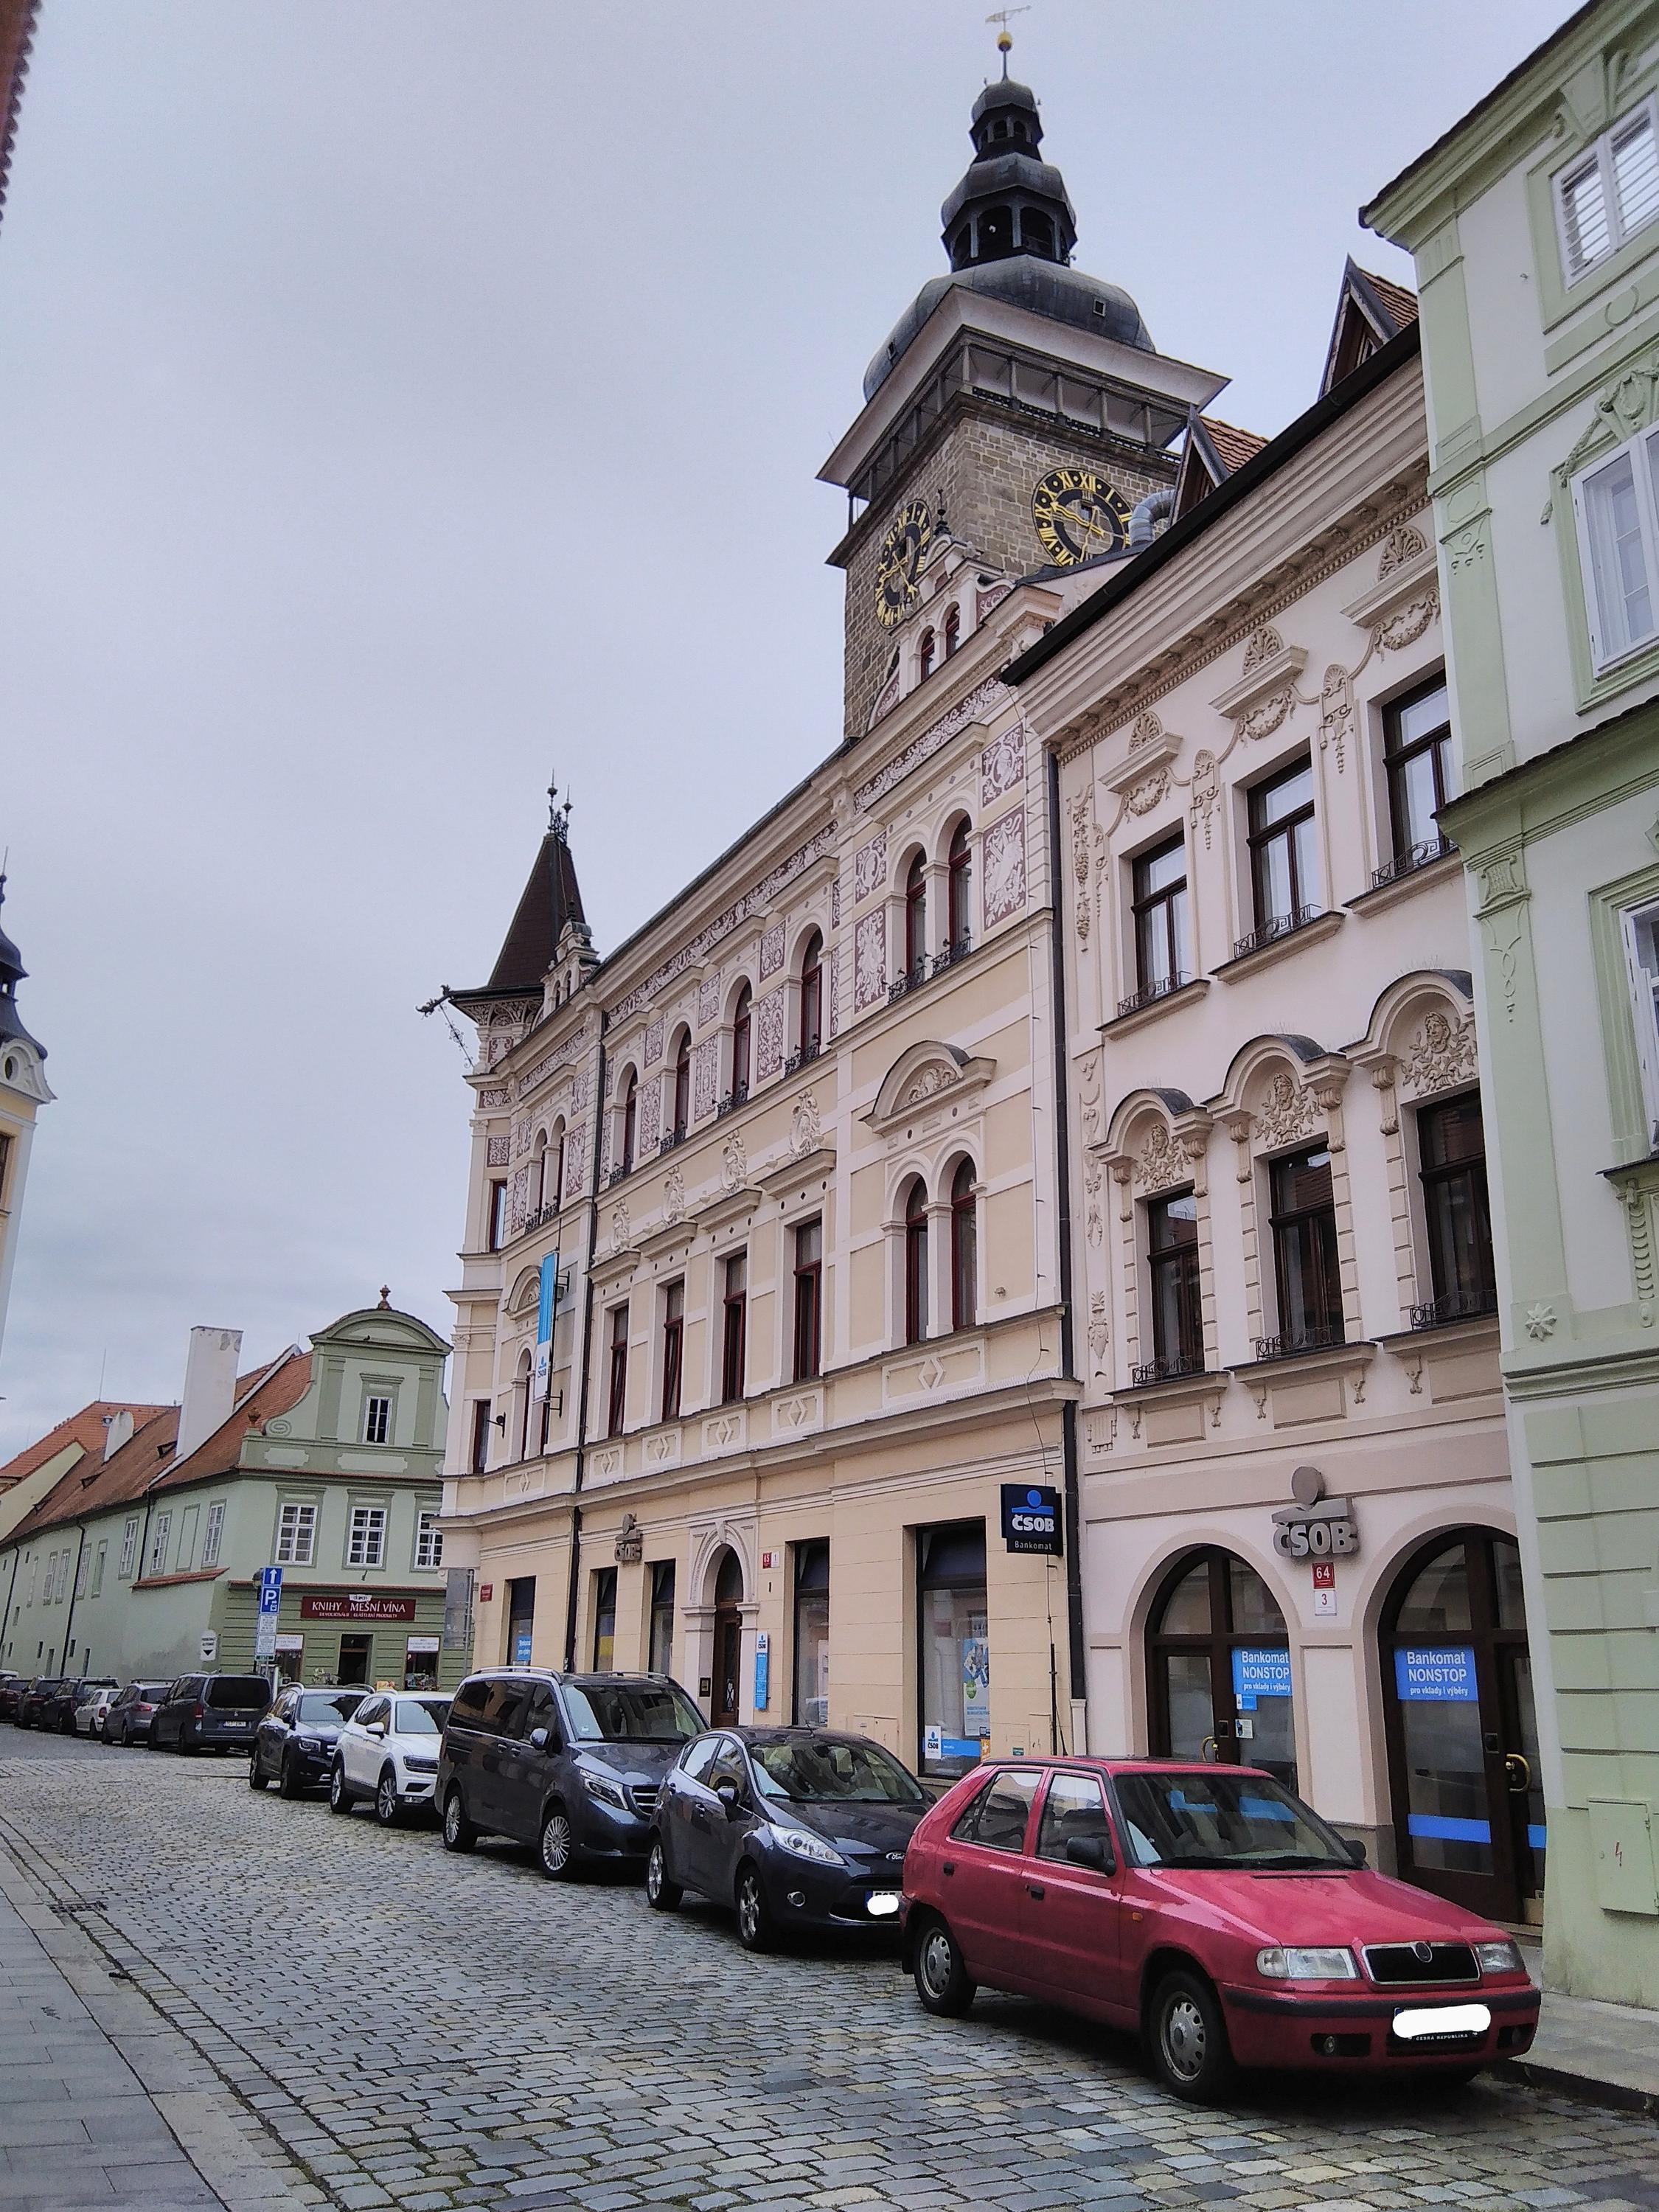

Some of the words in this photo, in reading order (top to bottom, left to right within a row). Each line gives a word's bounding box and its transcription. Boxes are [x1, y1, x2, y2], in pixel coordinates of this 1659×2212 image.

[1056, 471, 1074, 489] XI
[1079, 472, 1096, 493] XII
[1040, 483, 1057, 502] X
[1012, 1514, 1054, 1532] ČSOB
[1015, 1540, 1052, 1551] Bankomat
[1273, 1521, 1359, 1557] ČSOB
[1316, 1565, 1330, 1579] 64
[265, 1589, 277, 1606] P
[1321, 1593, 1327, 1605] 3
[312, 1601, 342, 1611] KNIHY
[350, 1601, 380, 1612] MEŠNÍ
[383, 1601, 406, 1613] VÍNA
[1242, 1651, 1289, 1663] Bankomat
[1407, 1651, 1466, 1665] Bankomat
[1242, 1666, 1290, 1679] NONSTOP
[1408, 1668, 1467, 1682] NONSTOP
[1410, 1687, 1421, 1696] pro
[1422, 1686, 1441, 1696] vklady
[1447, 1686, 1468, 1697] výběry
